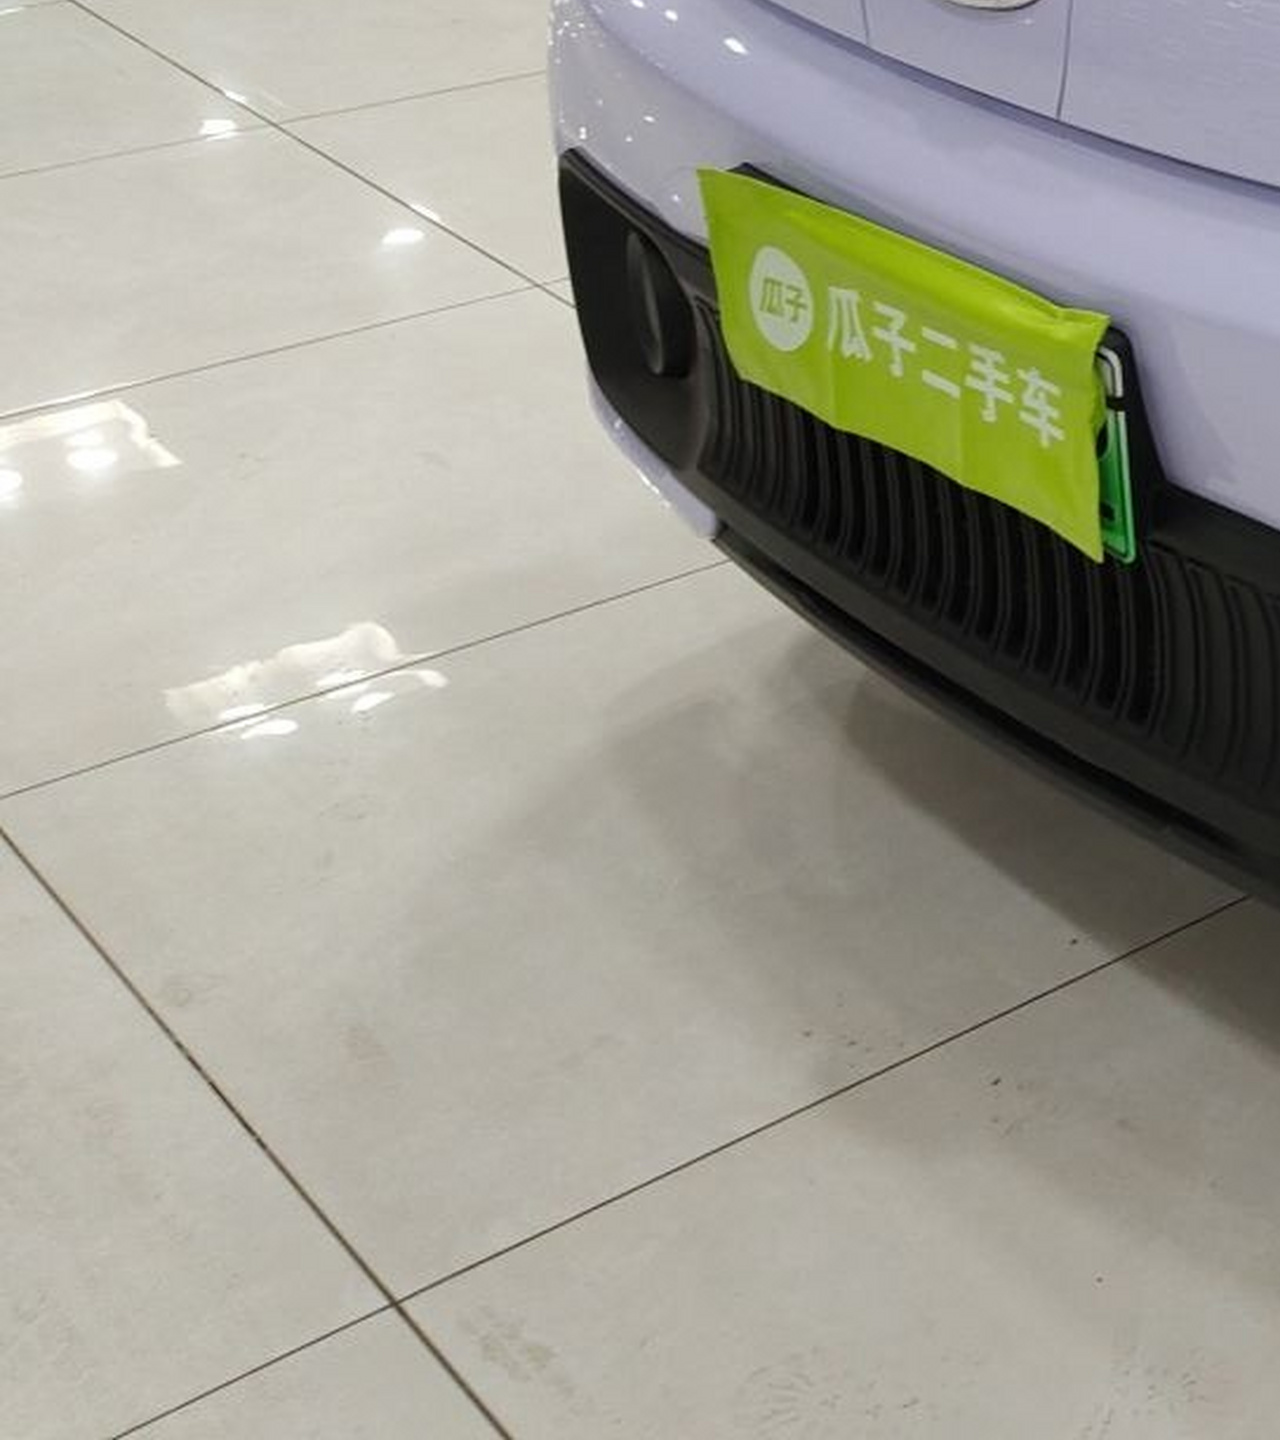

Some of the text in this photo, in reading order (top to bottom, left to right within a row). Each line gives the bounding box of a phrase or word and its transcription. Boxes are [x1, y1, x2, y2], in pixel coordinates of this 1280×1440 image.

[759, 277, 808, 323] 瓜子
[828, 286, 1065, 447] 瓜子二手车
